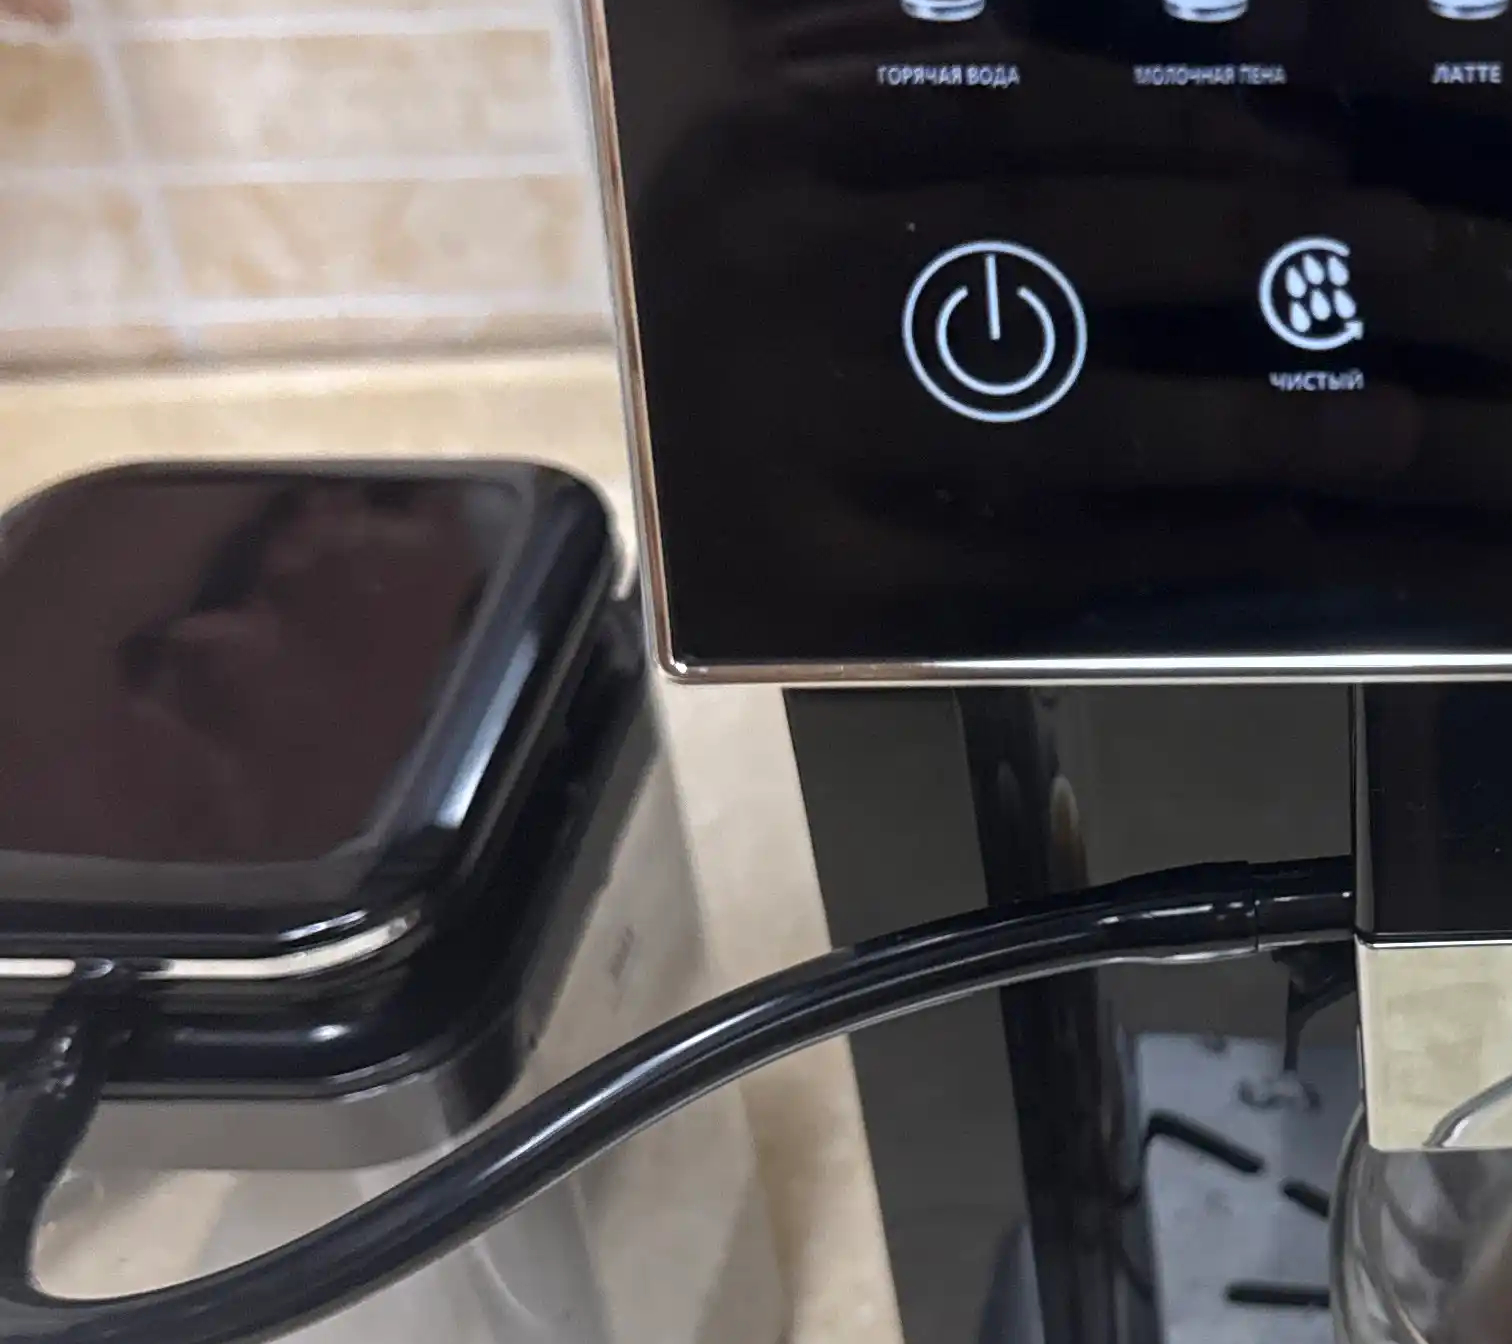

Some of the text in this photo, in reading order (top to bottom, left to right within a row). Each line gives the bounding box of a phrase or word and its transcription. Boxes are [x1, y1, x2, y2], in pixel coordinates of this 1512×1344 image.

[877, 63, 1021, 89] ГОРЯЧАЯ ВОДА
[1431, 62, 1502, 85] ЛАТТЕ
[1268, 367, 1365, 391] ЧИСТЫЙ
